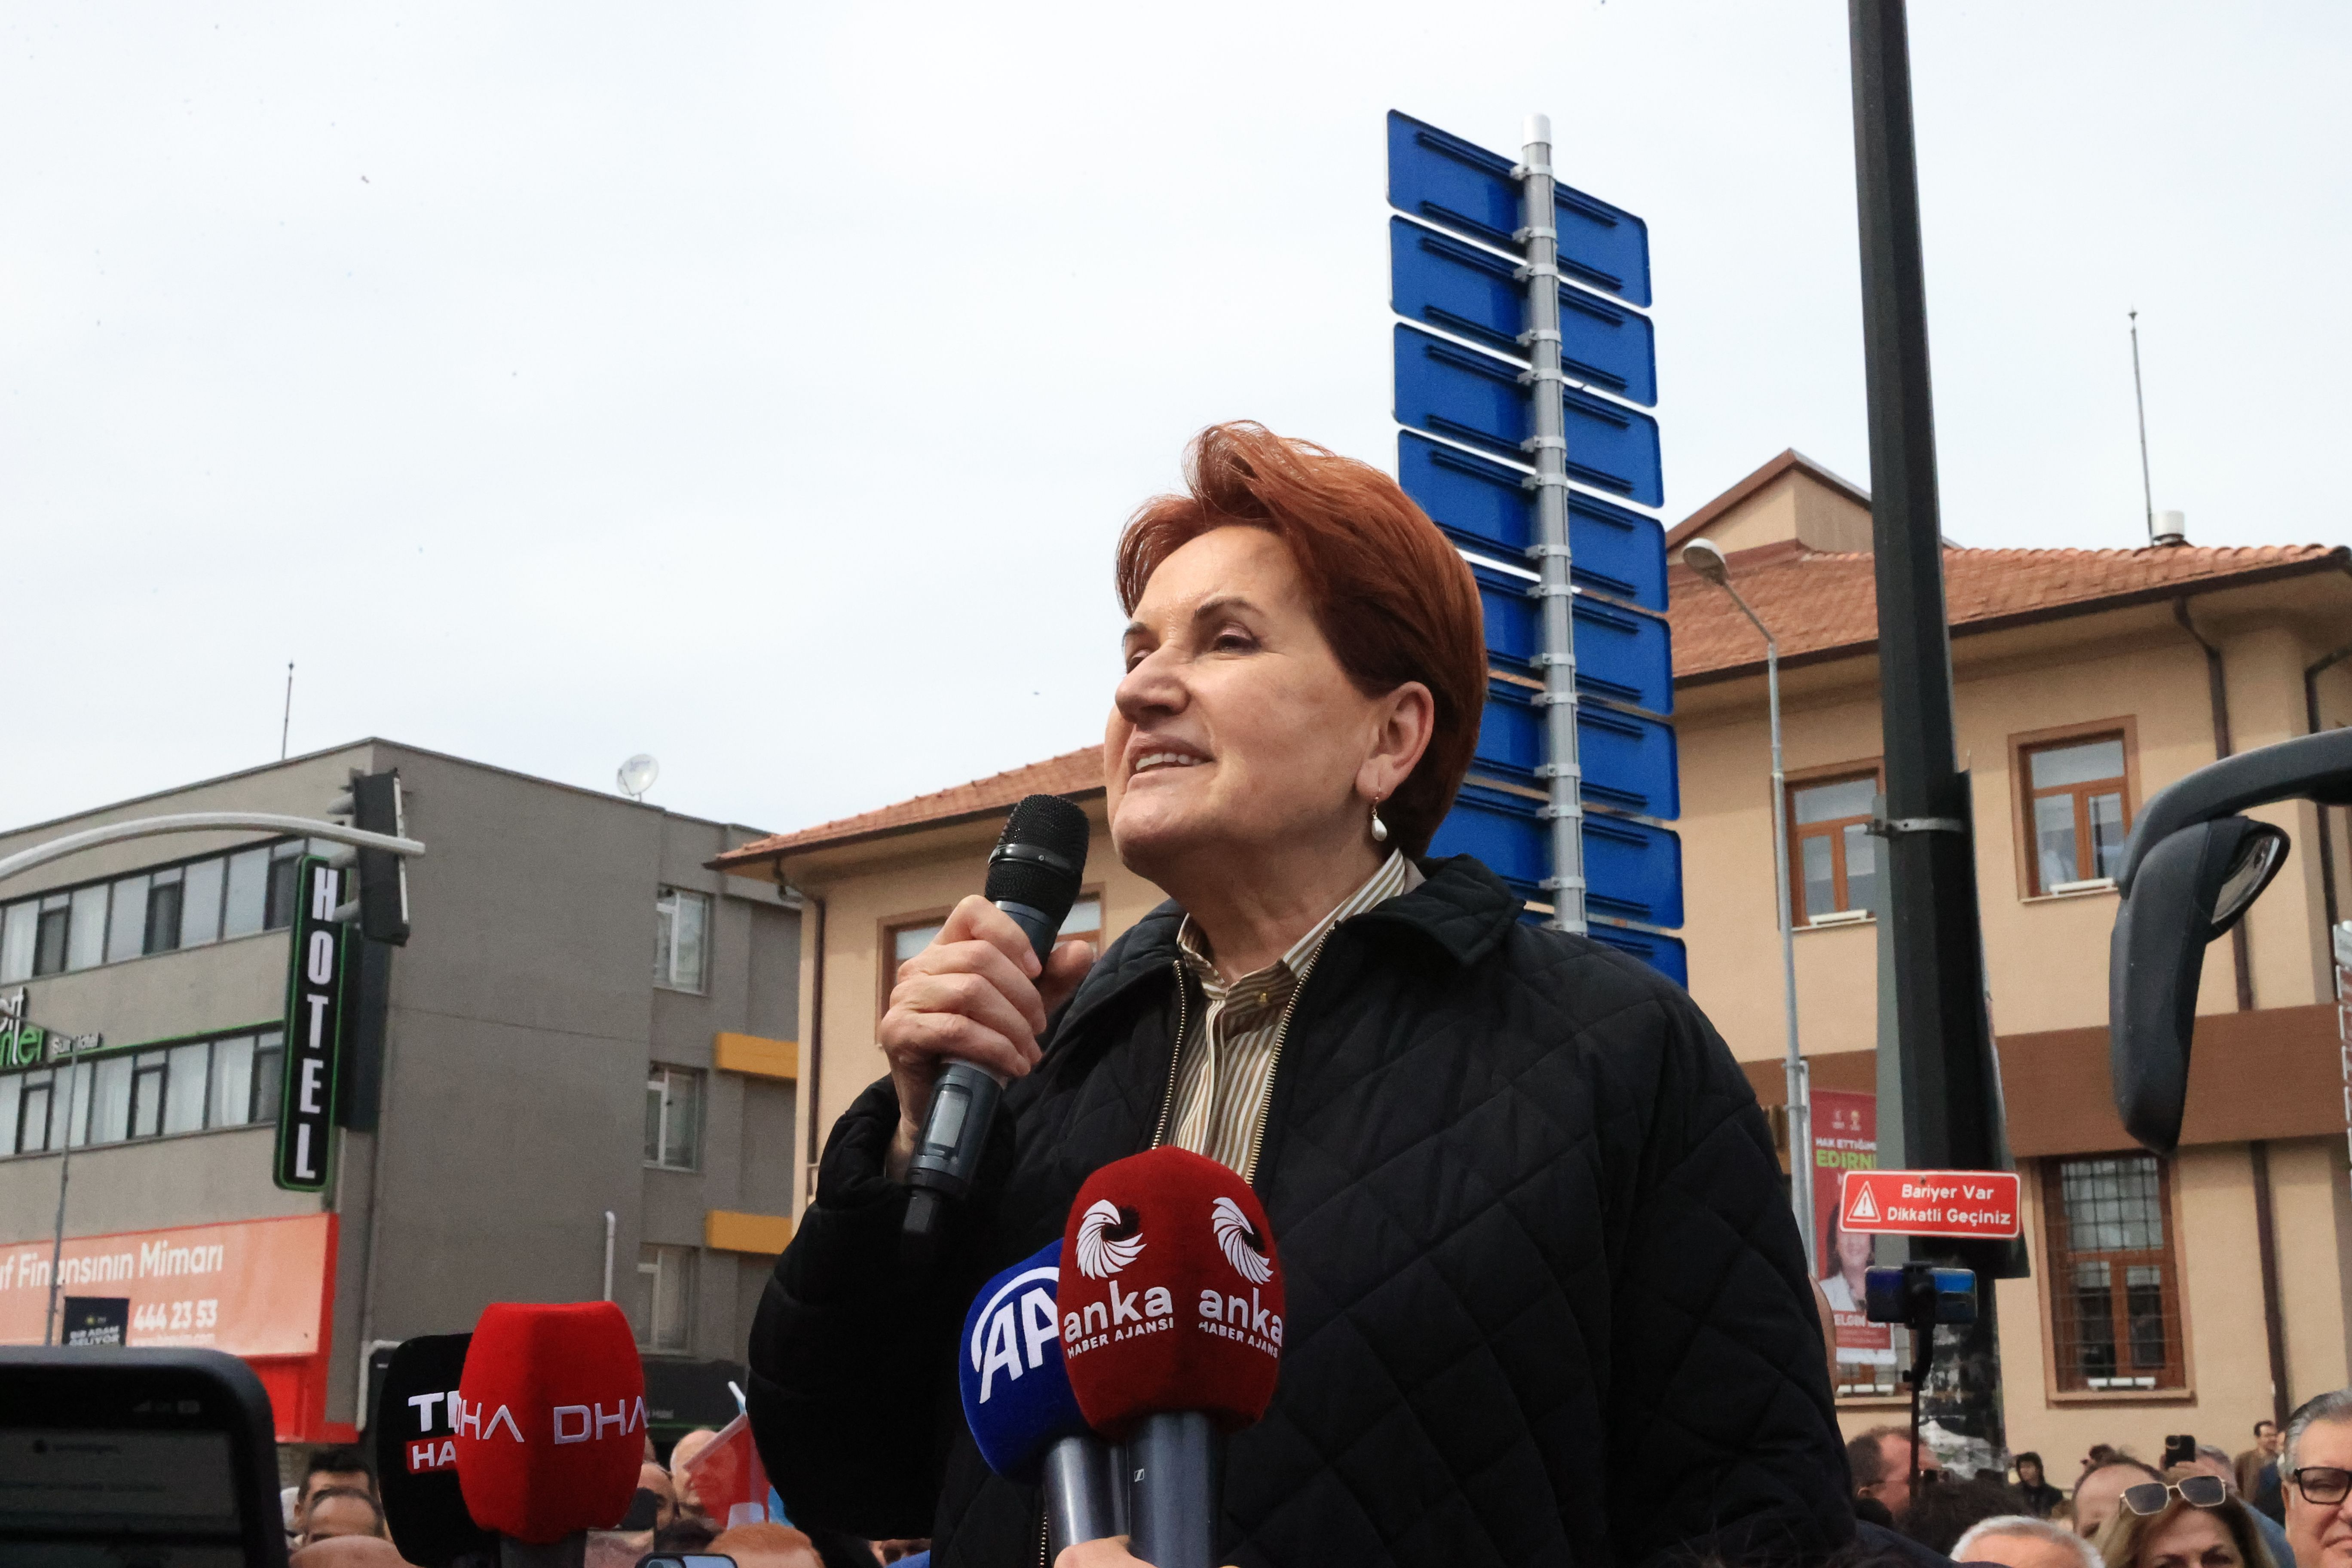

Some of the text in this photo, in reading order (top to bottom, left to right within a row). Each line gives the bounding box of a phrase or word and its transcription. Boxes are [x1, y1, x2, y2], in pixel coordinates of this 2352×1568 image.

[295, 867, 338, 1179] HOTEL
[1902, 1183, 1994, 1203] Bariyer Var
[1887, 1206, 2011, 1227] Dikkatli Geçiniz
[139, 1239, 224, 1278] Mimarı
[133, 1299, 218, 1332] 444 23 53
[1064, 1280, 1173, 1343] anka
[1199, 1287, 1283, 1347] anka
[1067, 1317, 1173, 1359] HABER AJANSI
[1198, 1321, 1244, 1343] HABER
[554, 1396, 649, 1445] DHA
